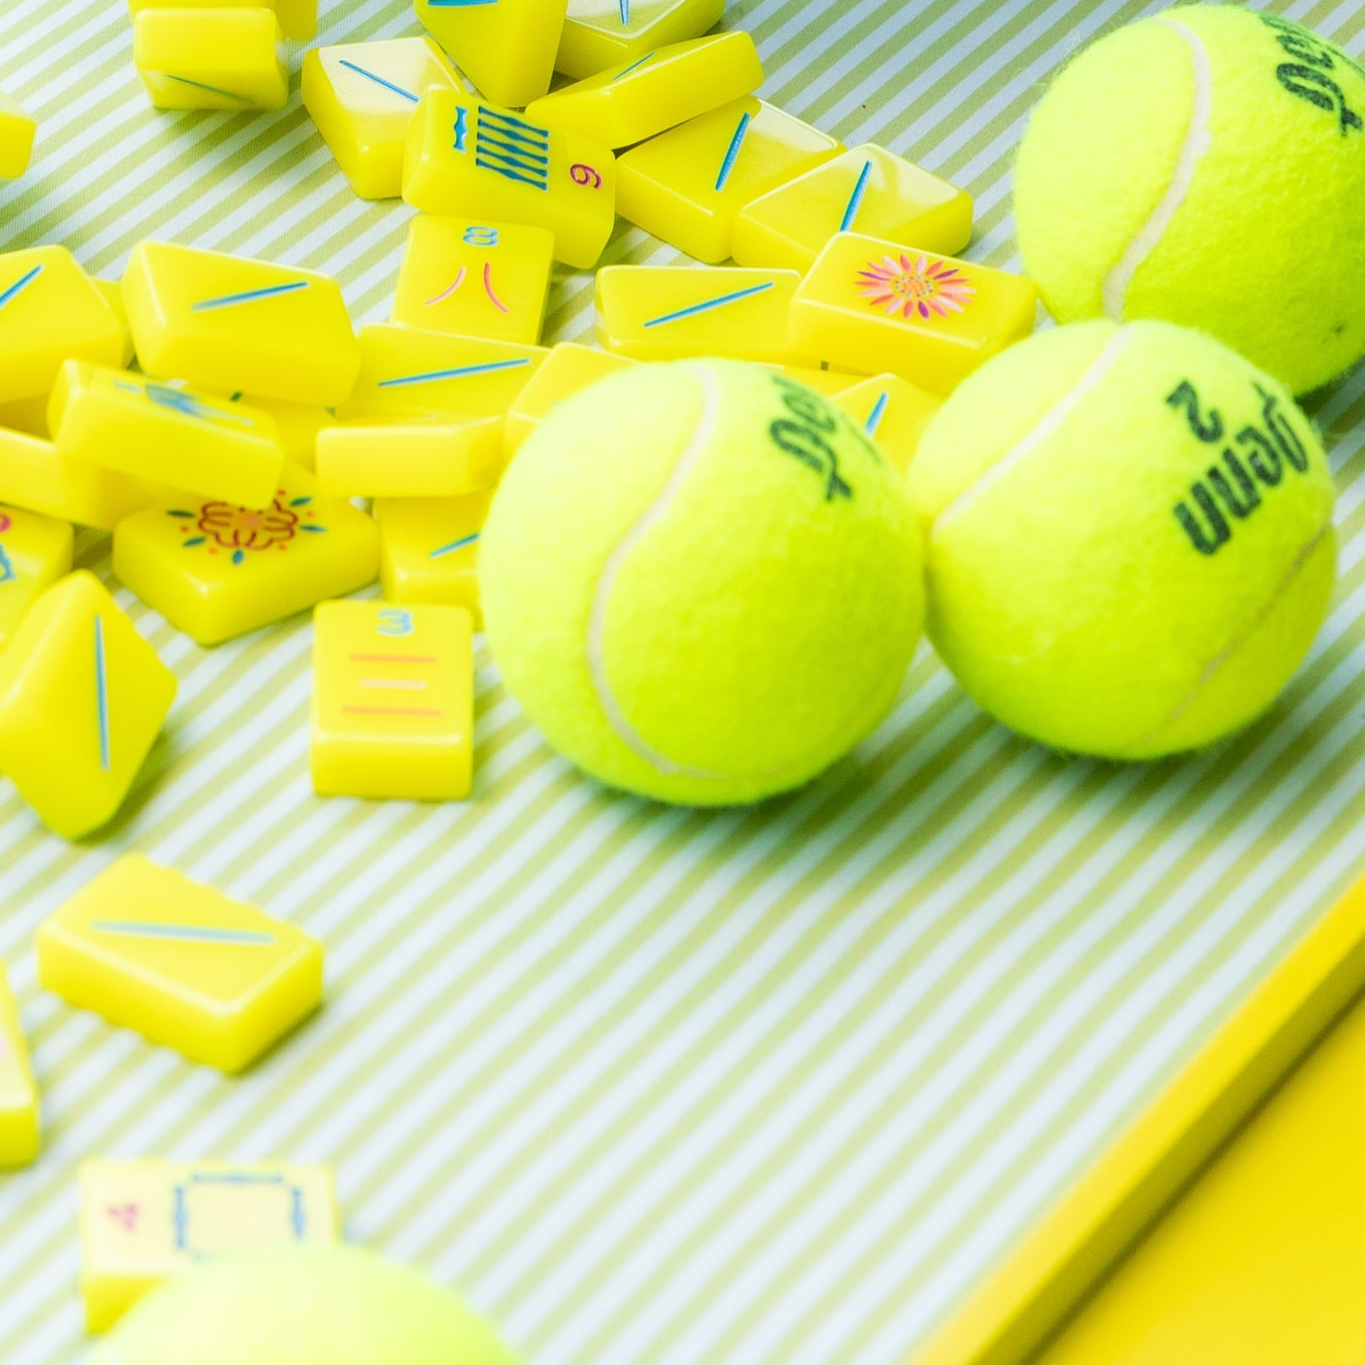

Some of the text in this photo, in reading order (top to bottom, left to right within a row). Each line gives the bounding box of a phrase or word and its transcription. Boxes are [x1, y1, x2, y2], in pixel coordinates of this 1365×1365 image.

[461, 225, 500, 248] 8
[1165, 379, 1224, 444] 2
[377, 608, 414, 638] 3
